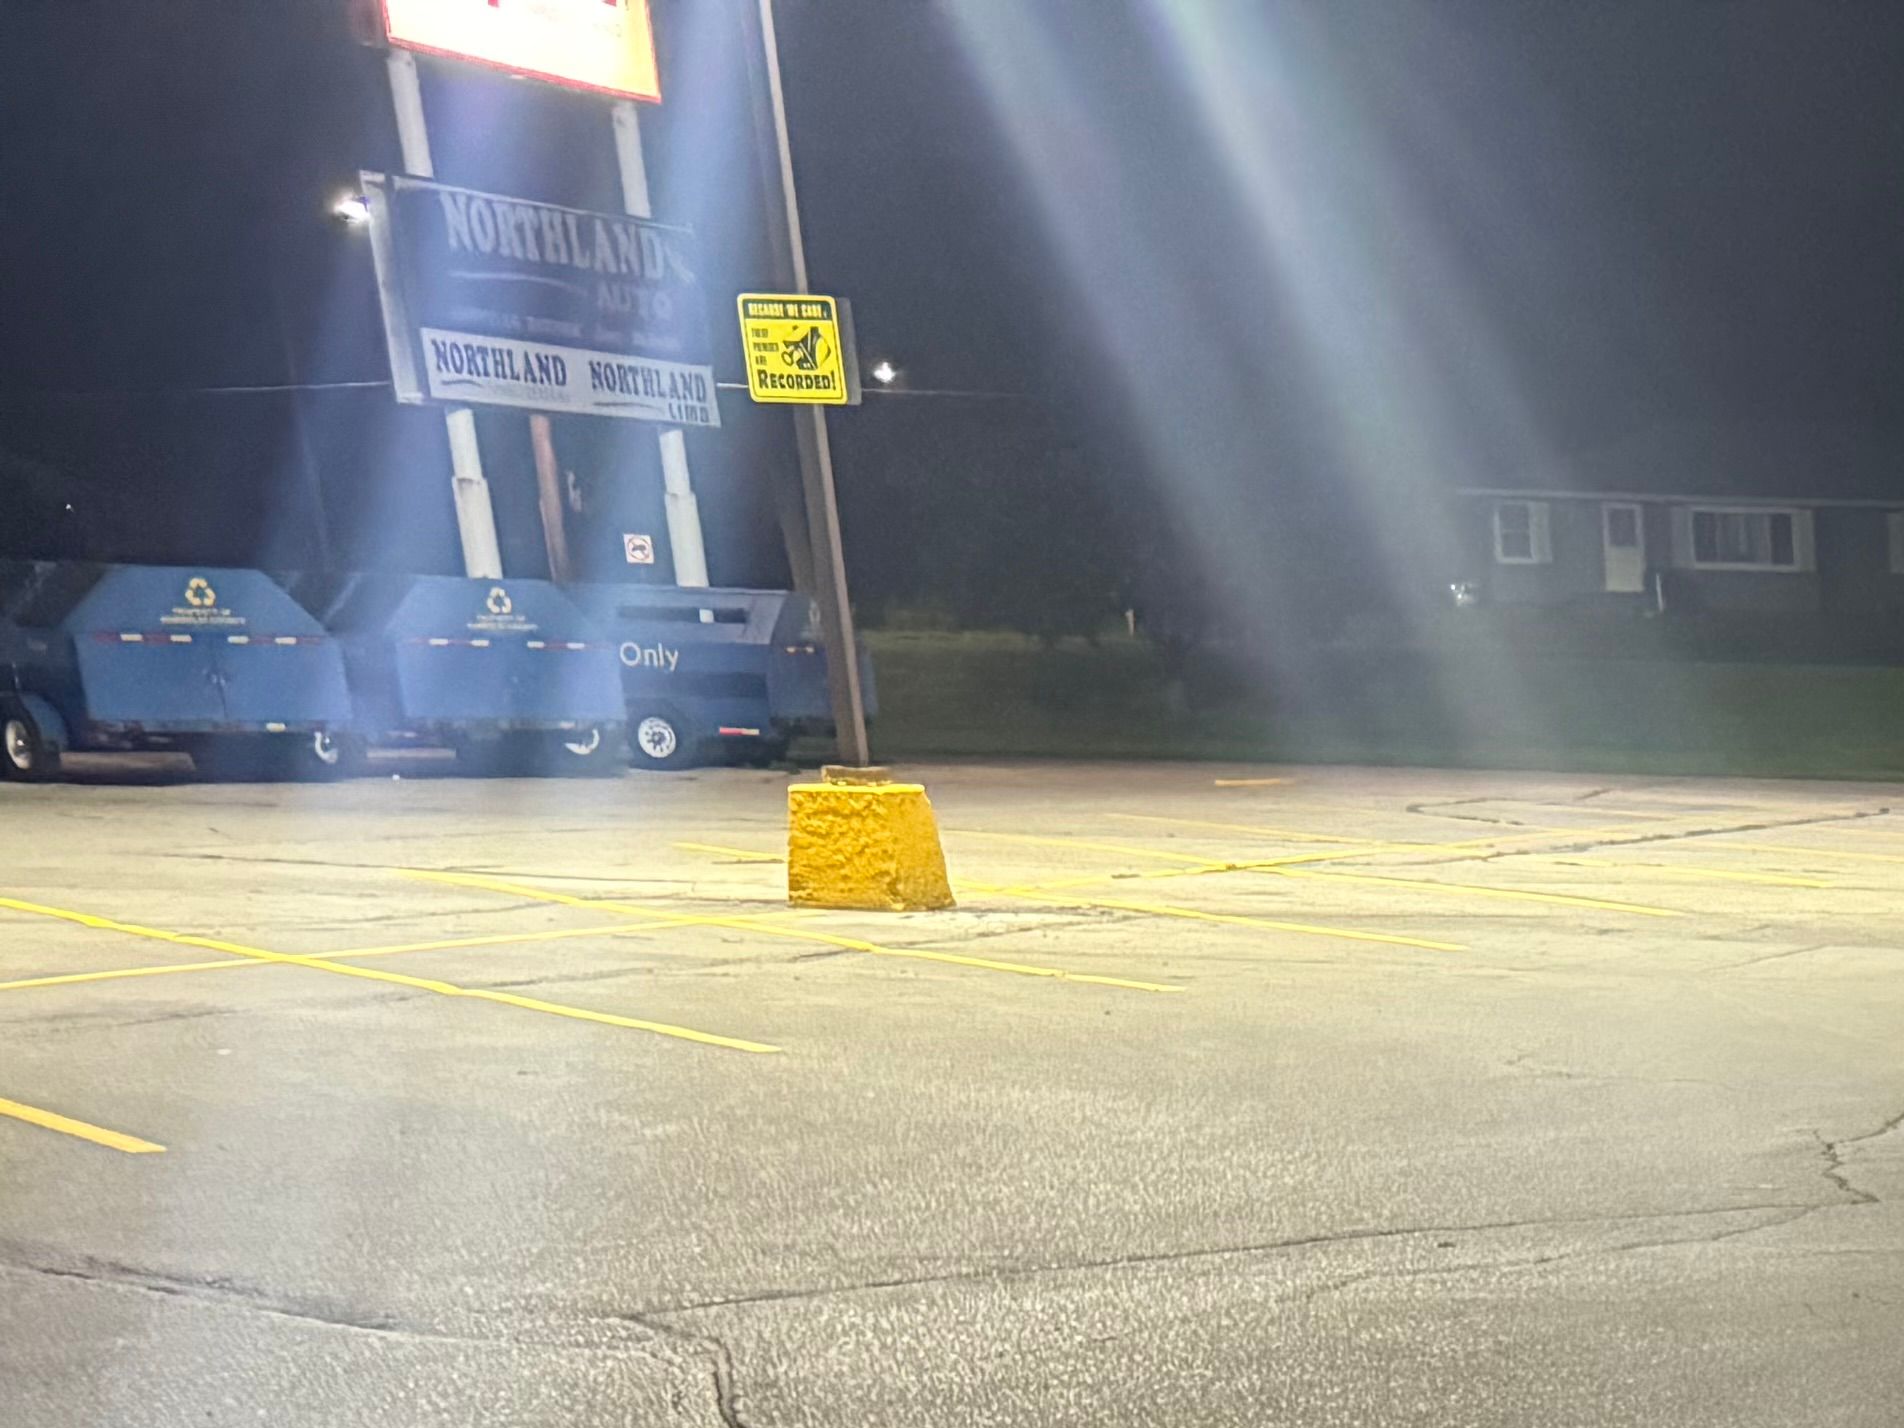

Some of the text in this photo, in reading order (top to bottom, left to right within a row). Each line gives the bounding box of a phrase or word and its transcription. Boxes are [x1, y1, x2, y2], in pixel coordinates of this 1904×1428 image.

[440, 191, 665, 280] NORTHLAND
[431, 339, 567, 387] NORTHLAND
[589, 360, 708, 403] NORTHLAND
[757, 369, 836, 391] RECORDED!
[619, 641, 679, 672] Only
